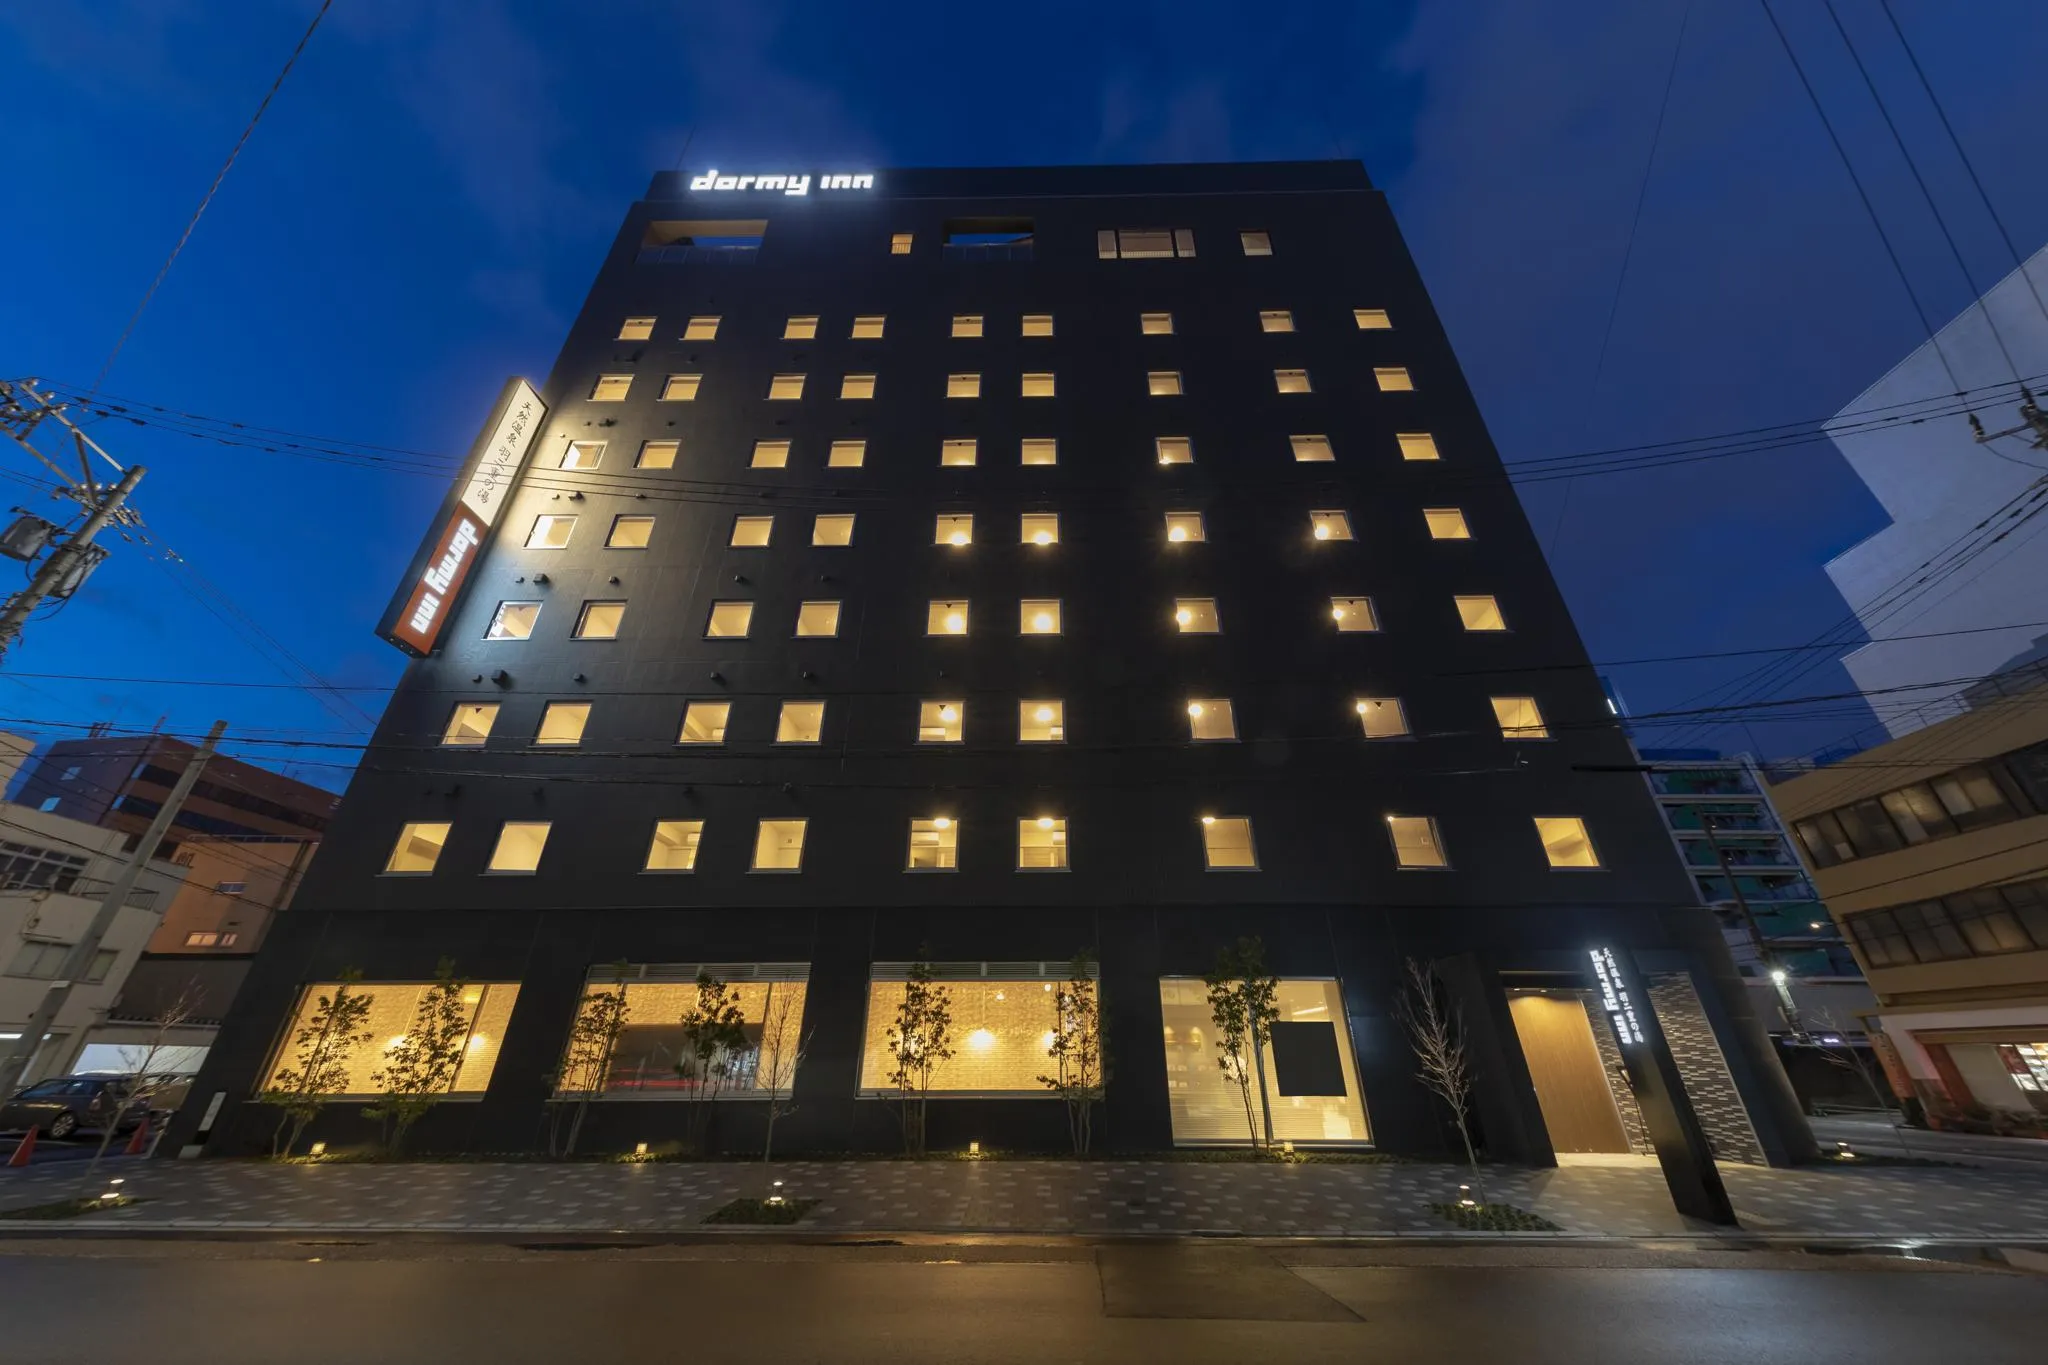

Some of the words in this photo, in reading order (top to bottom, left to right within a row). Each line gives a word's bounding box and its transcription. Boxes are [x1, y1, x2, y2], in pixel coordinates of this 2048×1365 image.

[690, 169, 811, 196] dormy
[819, 174, 873, 189] inn
[506, 401, 532, 448] 天然温泉
[424, 518, 480, 595] dormy
[410, 594, 440, 634] inn
[1589, 949, 1620, 1011] dormy
[1613, 1014, 1633, 1044] inn
